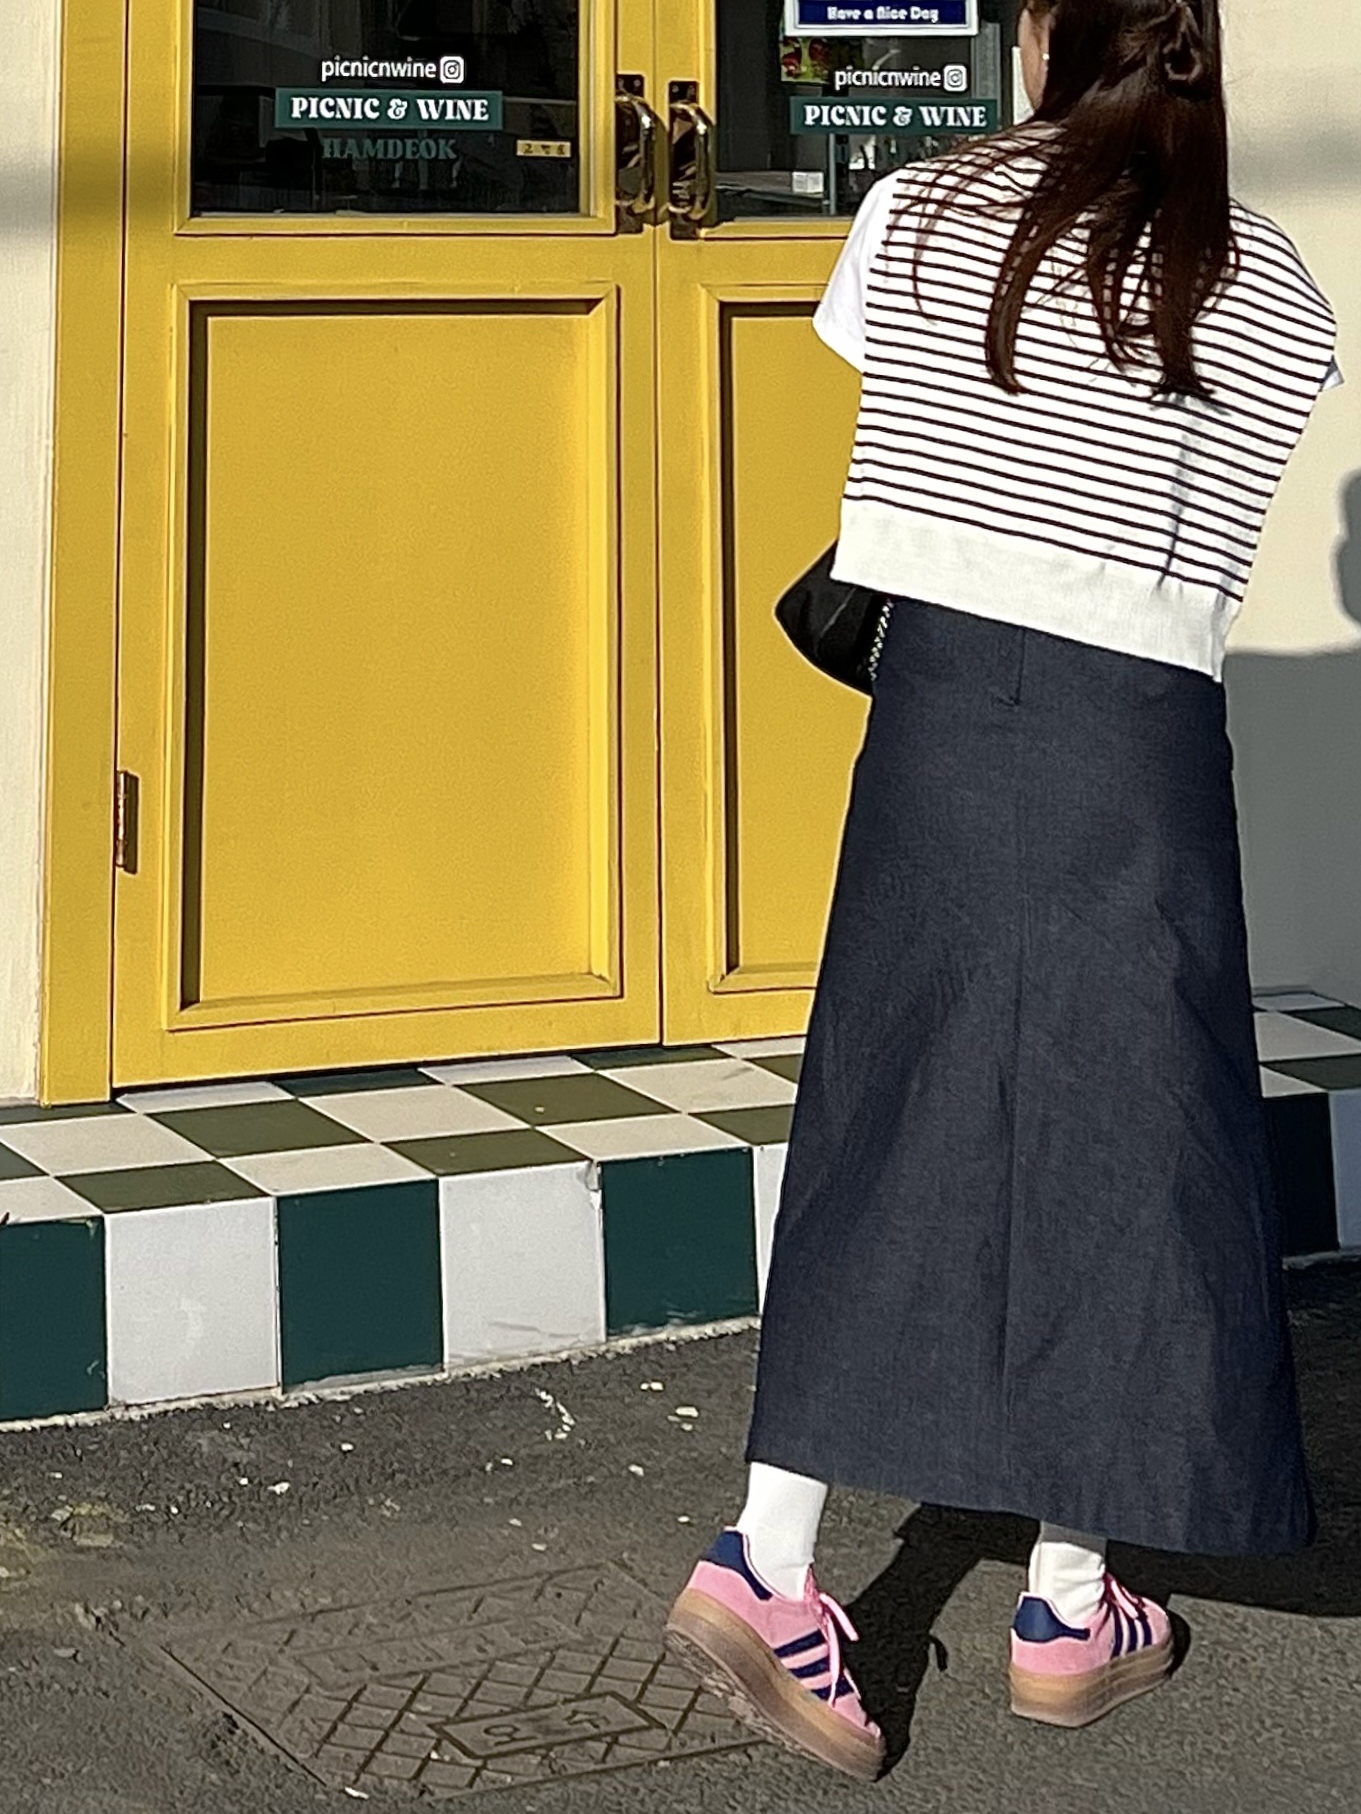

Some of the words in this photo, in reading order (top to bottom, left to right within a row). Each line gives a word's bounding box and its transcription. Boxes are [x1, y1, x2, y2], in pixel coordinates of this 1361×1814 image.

[827, 6, 861, 20] Have
[863, 9, 874, 20] a
[910, 6, 939, 23] Day
[321, 55, 437, 82] picnicnwine
[834, 66, 941, 90] picnicnwine
[290, 97, 380, 120] PICNIC
[387, 98, 408, 120] &
[416, 98, 489, 121] WINE
[804, 104, 887, 127] PICNIC
[892, 106, 913, 127] &
[918, 106, 987, 128] WINE
